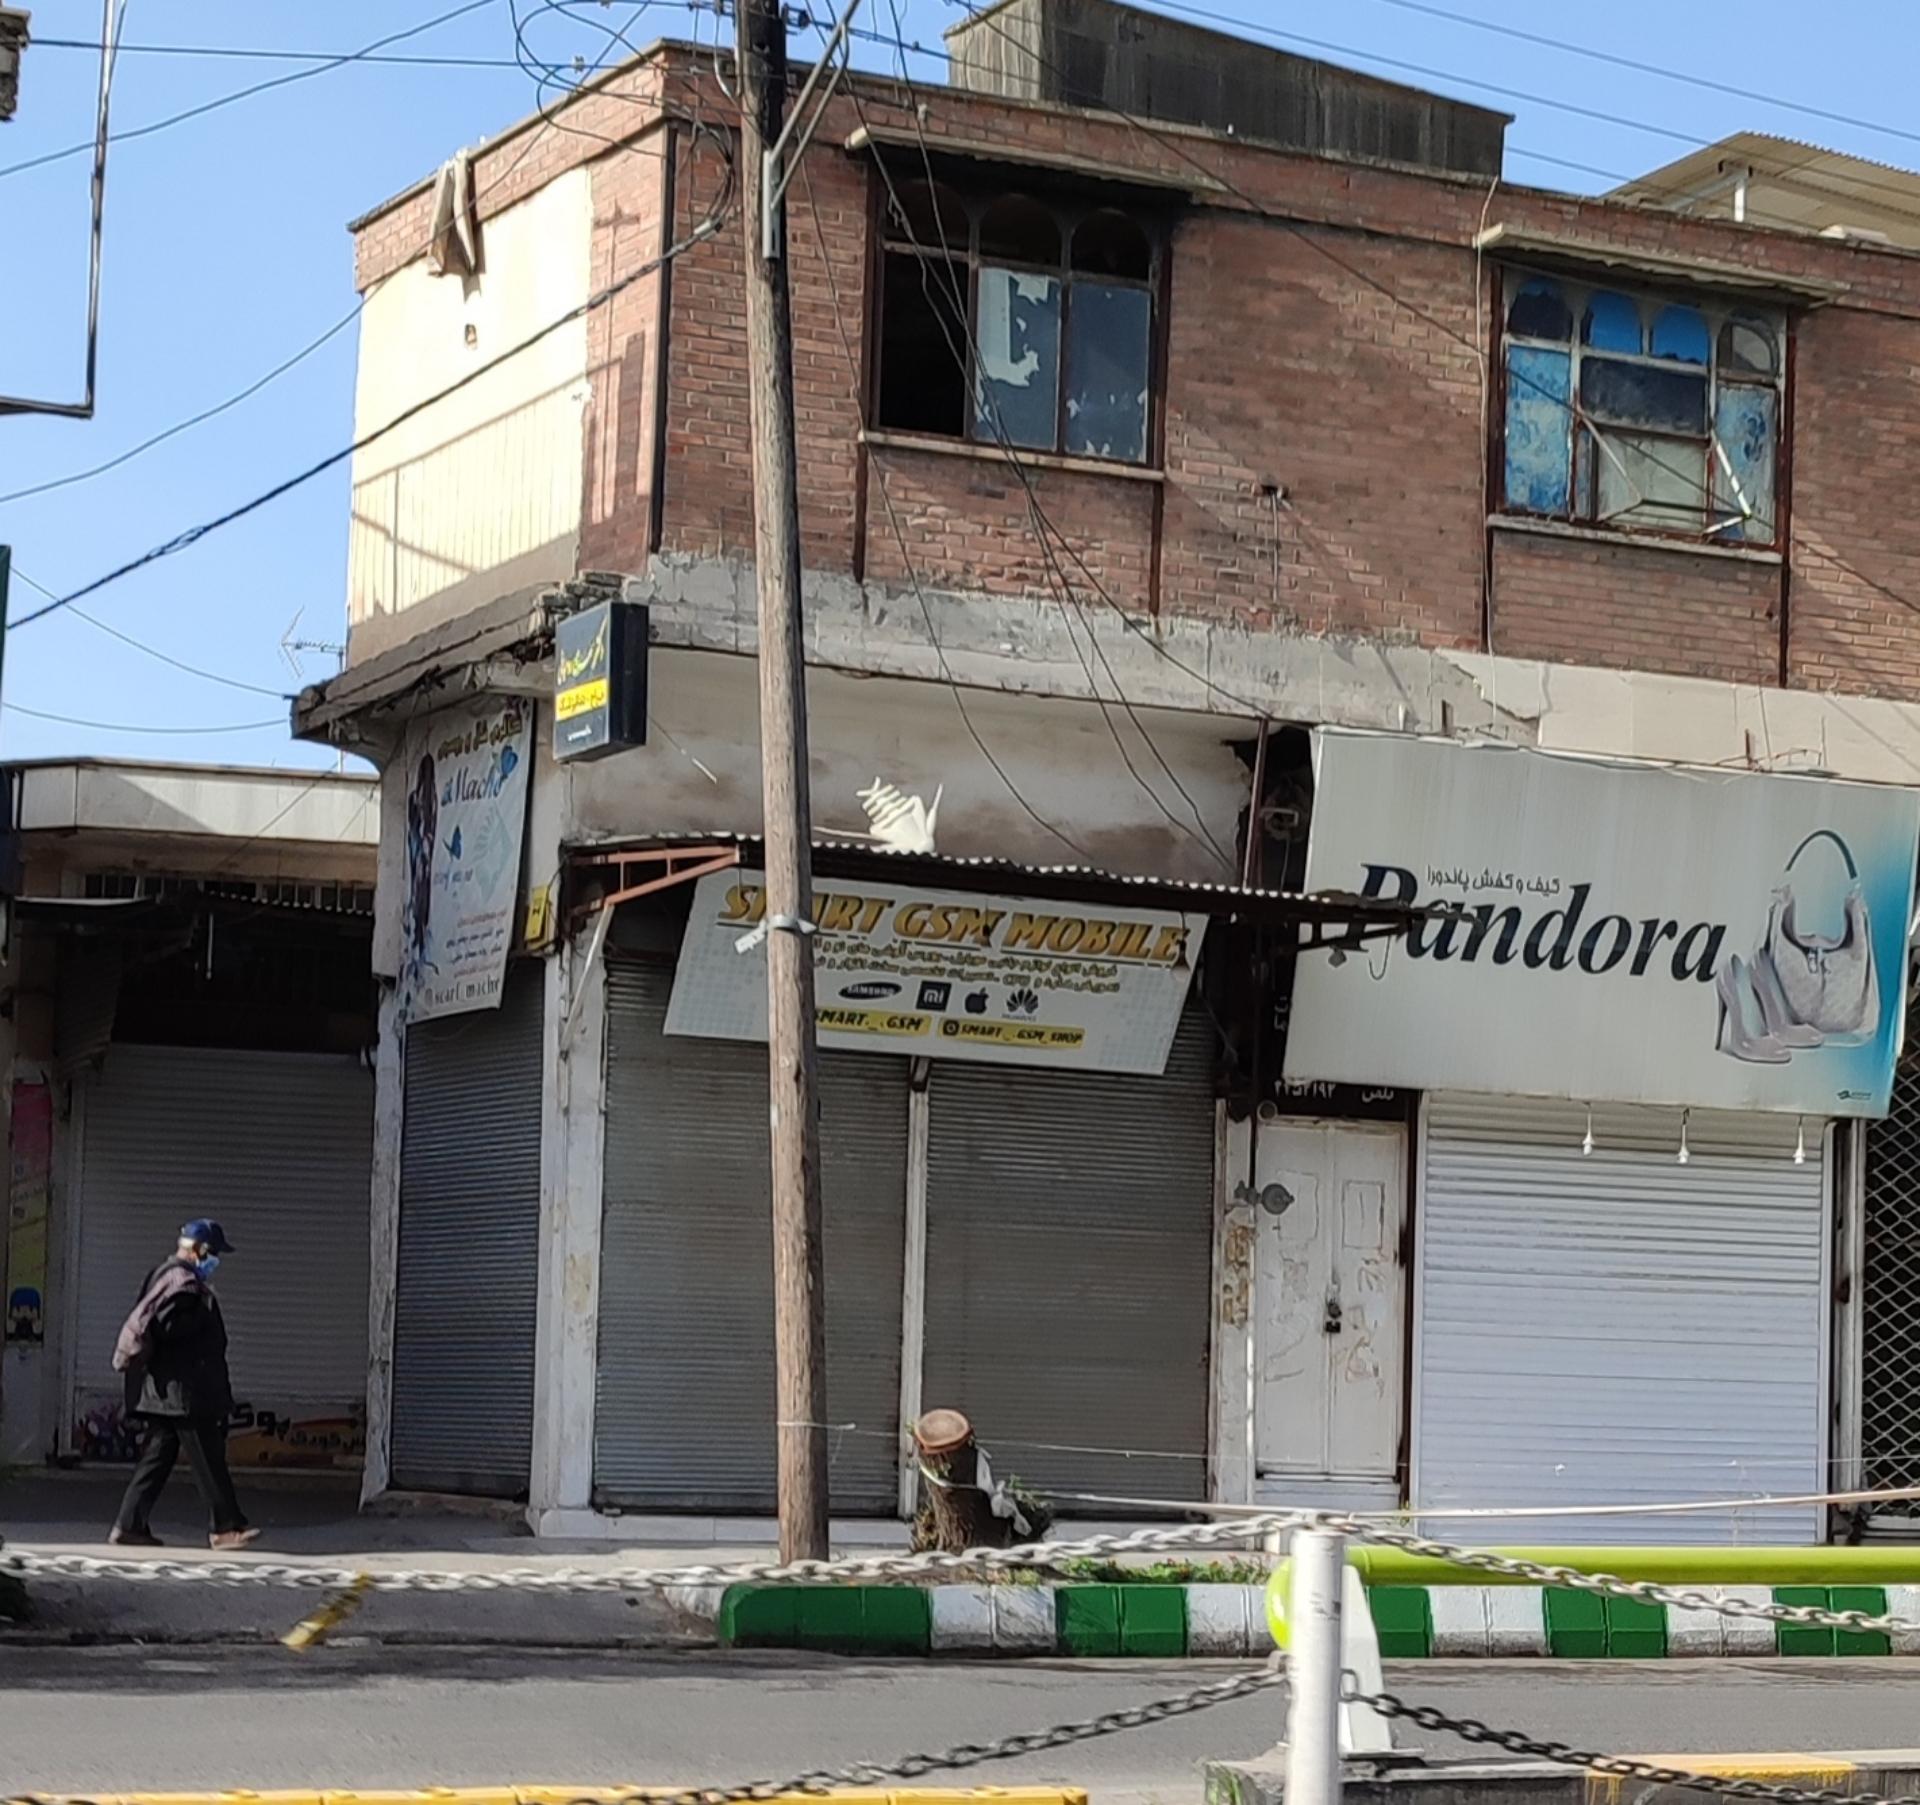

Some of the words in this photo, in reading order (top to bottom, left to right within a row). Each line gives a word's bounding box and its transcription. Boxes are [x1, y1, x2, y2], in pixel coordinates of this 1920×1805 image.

[1427, 864, 1470, 893] پاندورا
[1472, 867, 1514, 890] کفش
[1515, 878, 1524, 895] و
[1526, 876, 1561, 896] کیف
[893, 902, 1005, 948] GSM
[1001, 911, 1190, 962] MOBILE
[1341, 864, 1728, 982] Pandora
